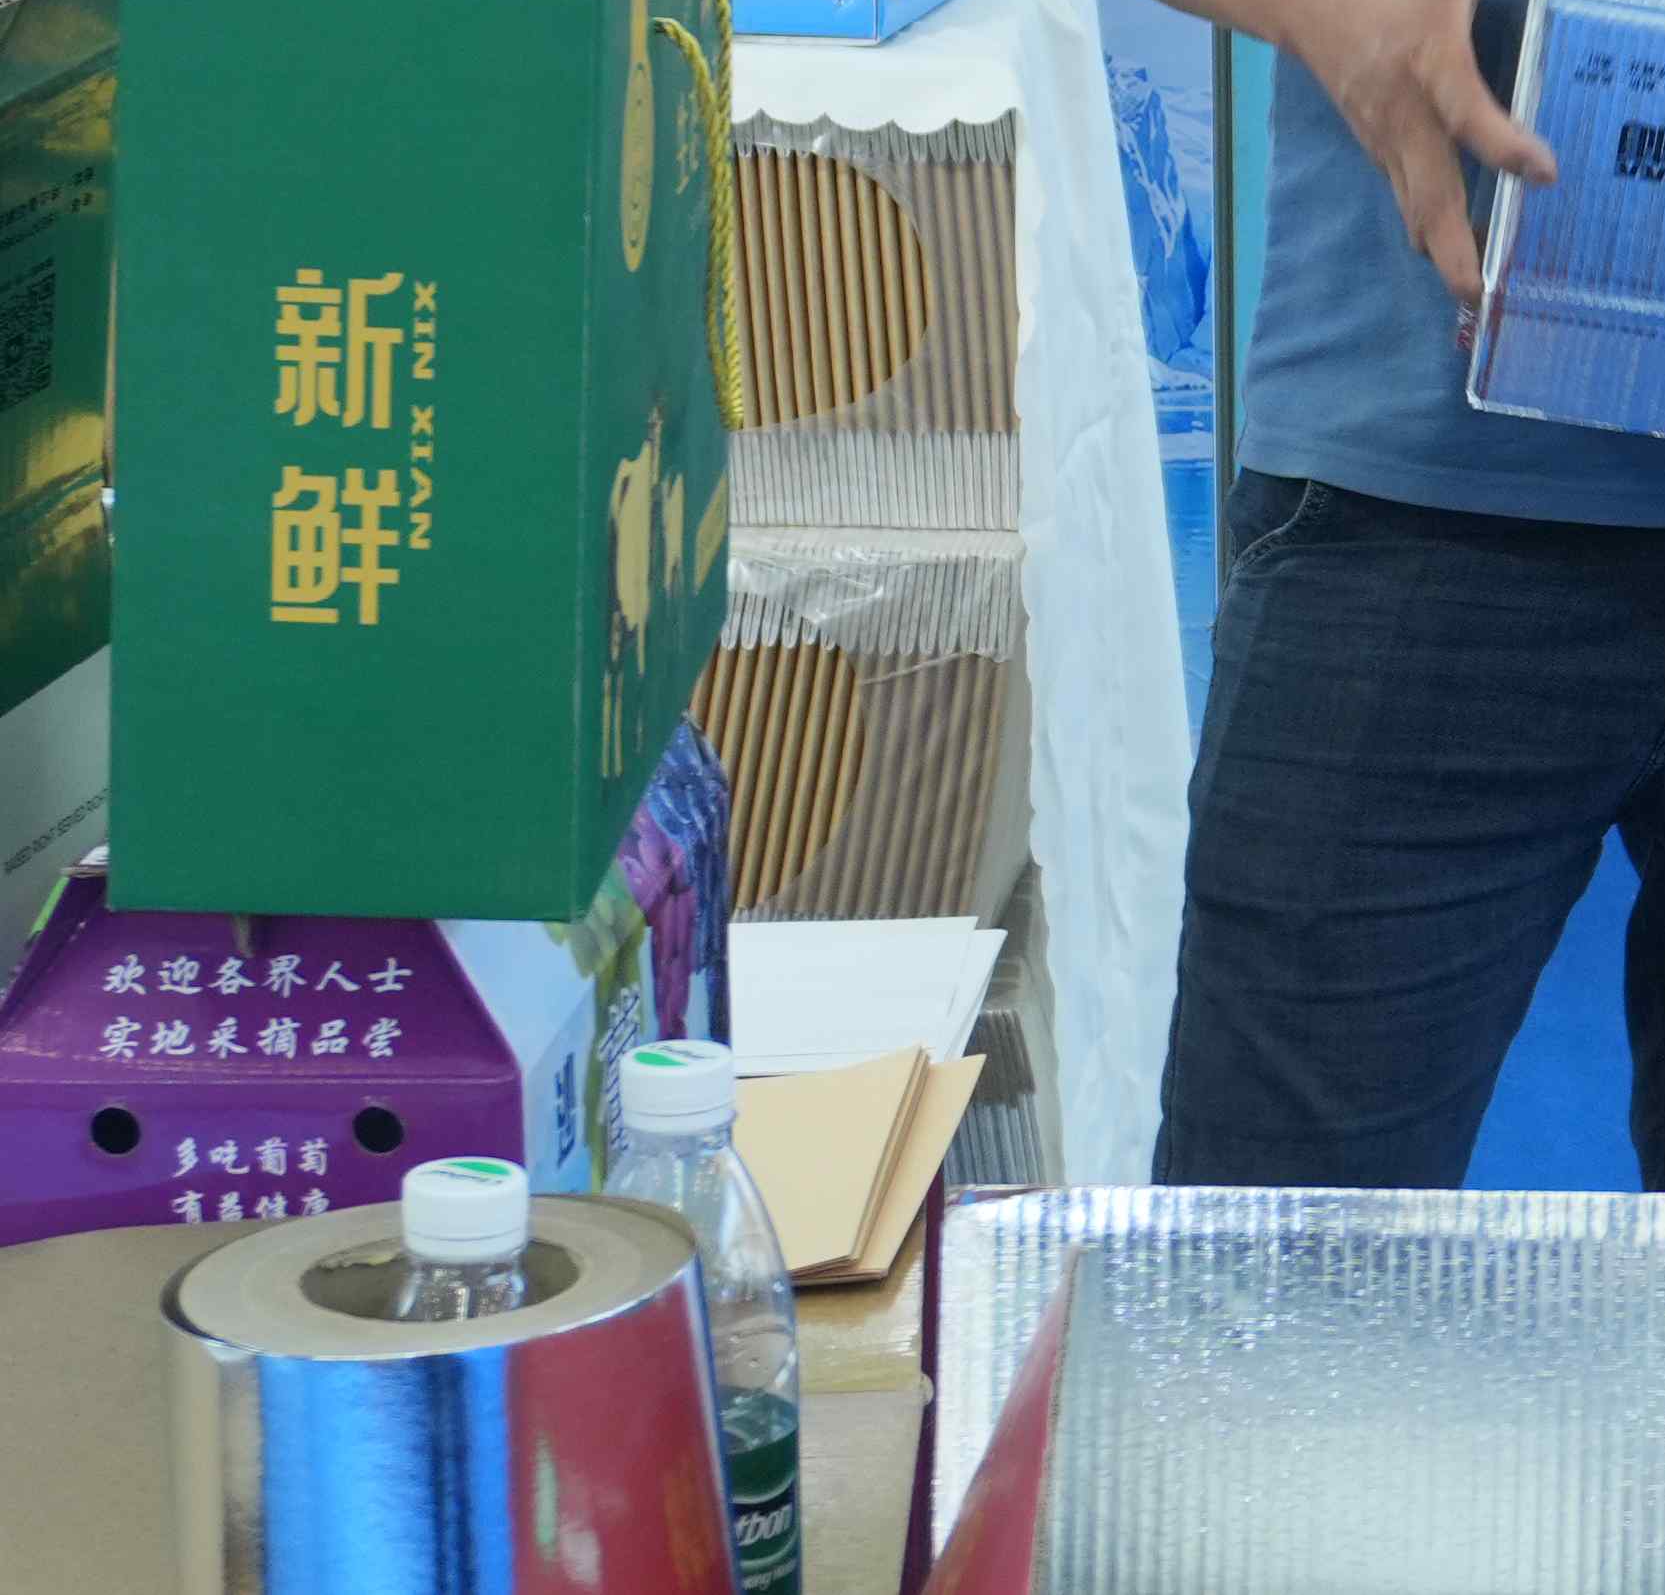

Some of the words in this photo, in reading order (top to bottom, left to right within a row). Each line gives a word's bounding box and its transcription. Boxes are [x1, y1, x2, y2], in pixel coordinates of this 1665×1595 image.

[413, 281, 438, 381] XIN
[269, 268, 405, 626] 新鲜
[409, 406, 436, 551] XIAN
[103, 954, 413, 998] 欢迎各界人士
[100, 1016, 402, 1059] 实地采摘品尝
[171, 1137, 330, 1178] 多吃葡萄
